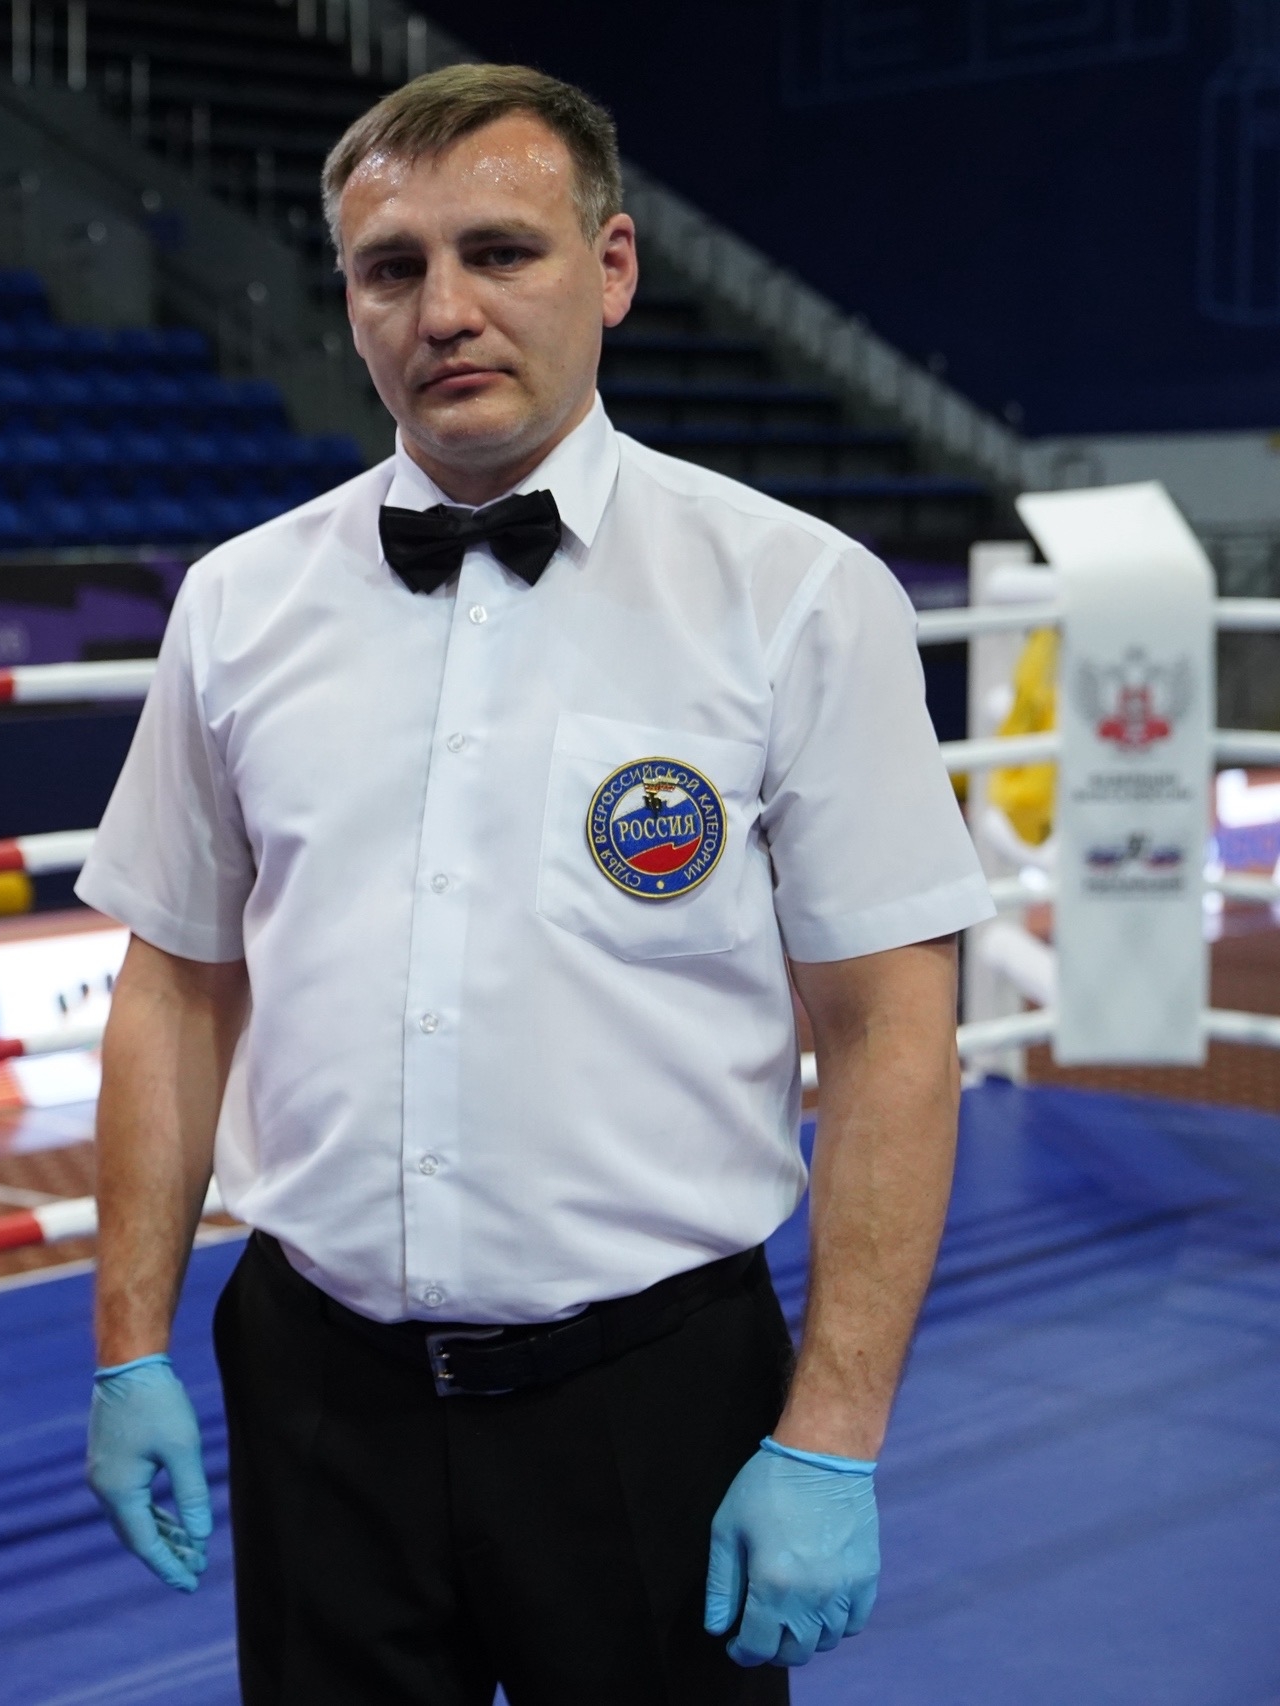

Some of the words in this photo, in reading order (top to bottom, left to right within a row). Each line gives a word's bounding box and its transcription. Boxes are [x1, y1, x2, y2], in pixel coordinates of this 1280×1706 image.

[593, 764, 701, 844] ВСЕРОССИЙСКОЙ
[617, 815, 695, 842] РОССИЯ
[599, 846, 641, 888] СУДЬЯ
[683, 793, 719, 881] КАТЕГОРИИ
